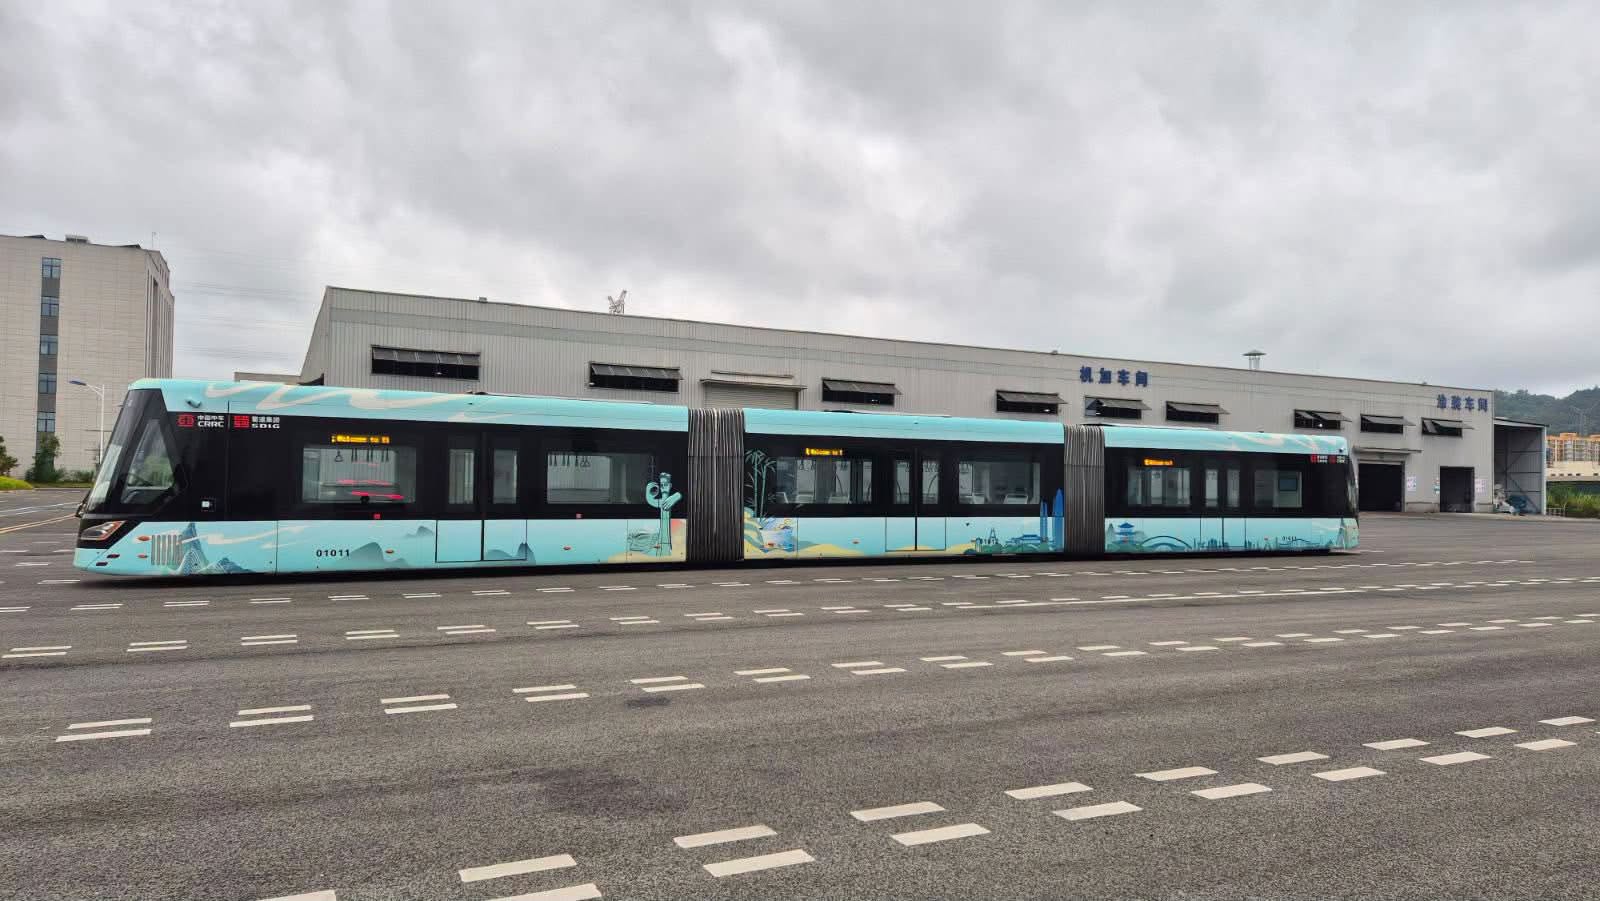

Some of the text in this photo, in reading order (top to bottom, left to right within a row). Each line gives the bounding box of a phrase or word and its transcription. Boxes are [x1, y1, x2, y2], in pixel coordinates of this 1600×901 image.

[1079, 365, 1148, 387] 机加车间
[197, 420, 224, 428] CRRC
[316, 549, 350, 557] 01011
